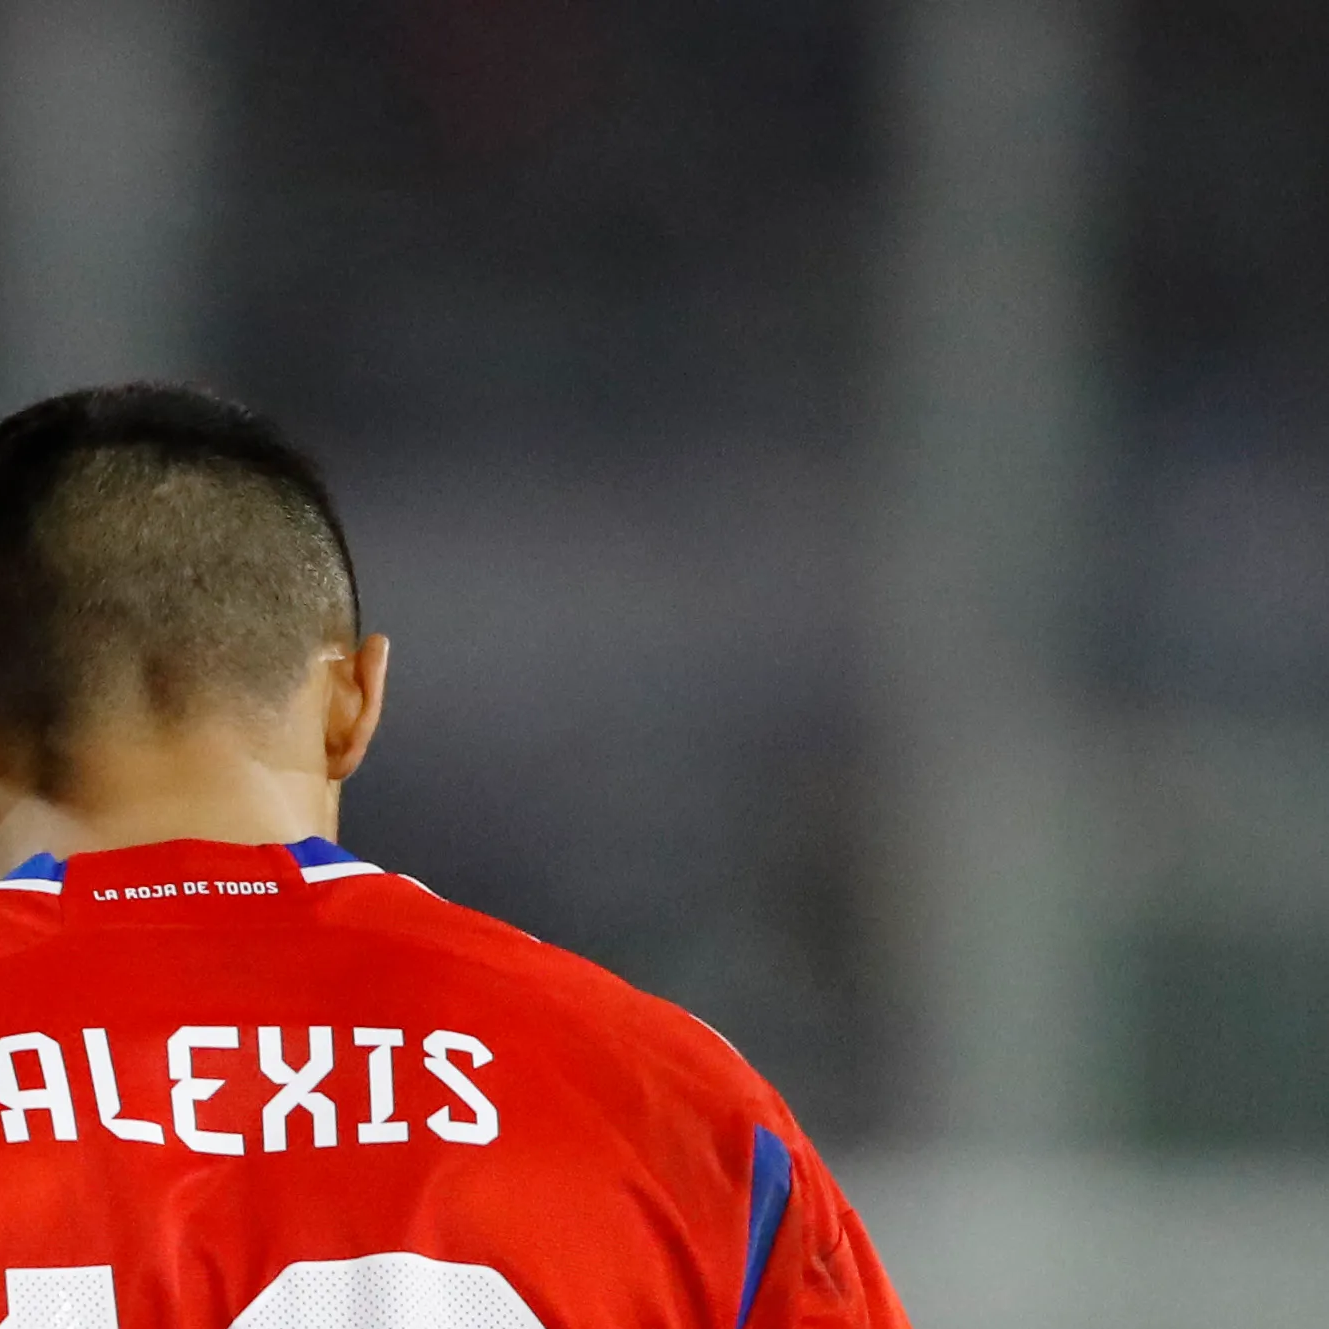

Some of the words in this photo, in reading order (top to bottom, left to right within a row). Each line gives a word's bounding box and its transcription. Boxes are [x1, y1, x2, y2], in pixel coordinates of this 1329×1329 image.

[93, 888, 119, 901] LA
[124, 883, 177, 900] ROJA
[183, 881, 210, 895] DE
[213, 881, 279, 895] TODOS
